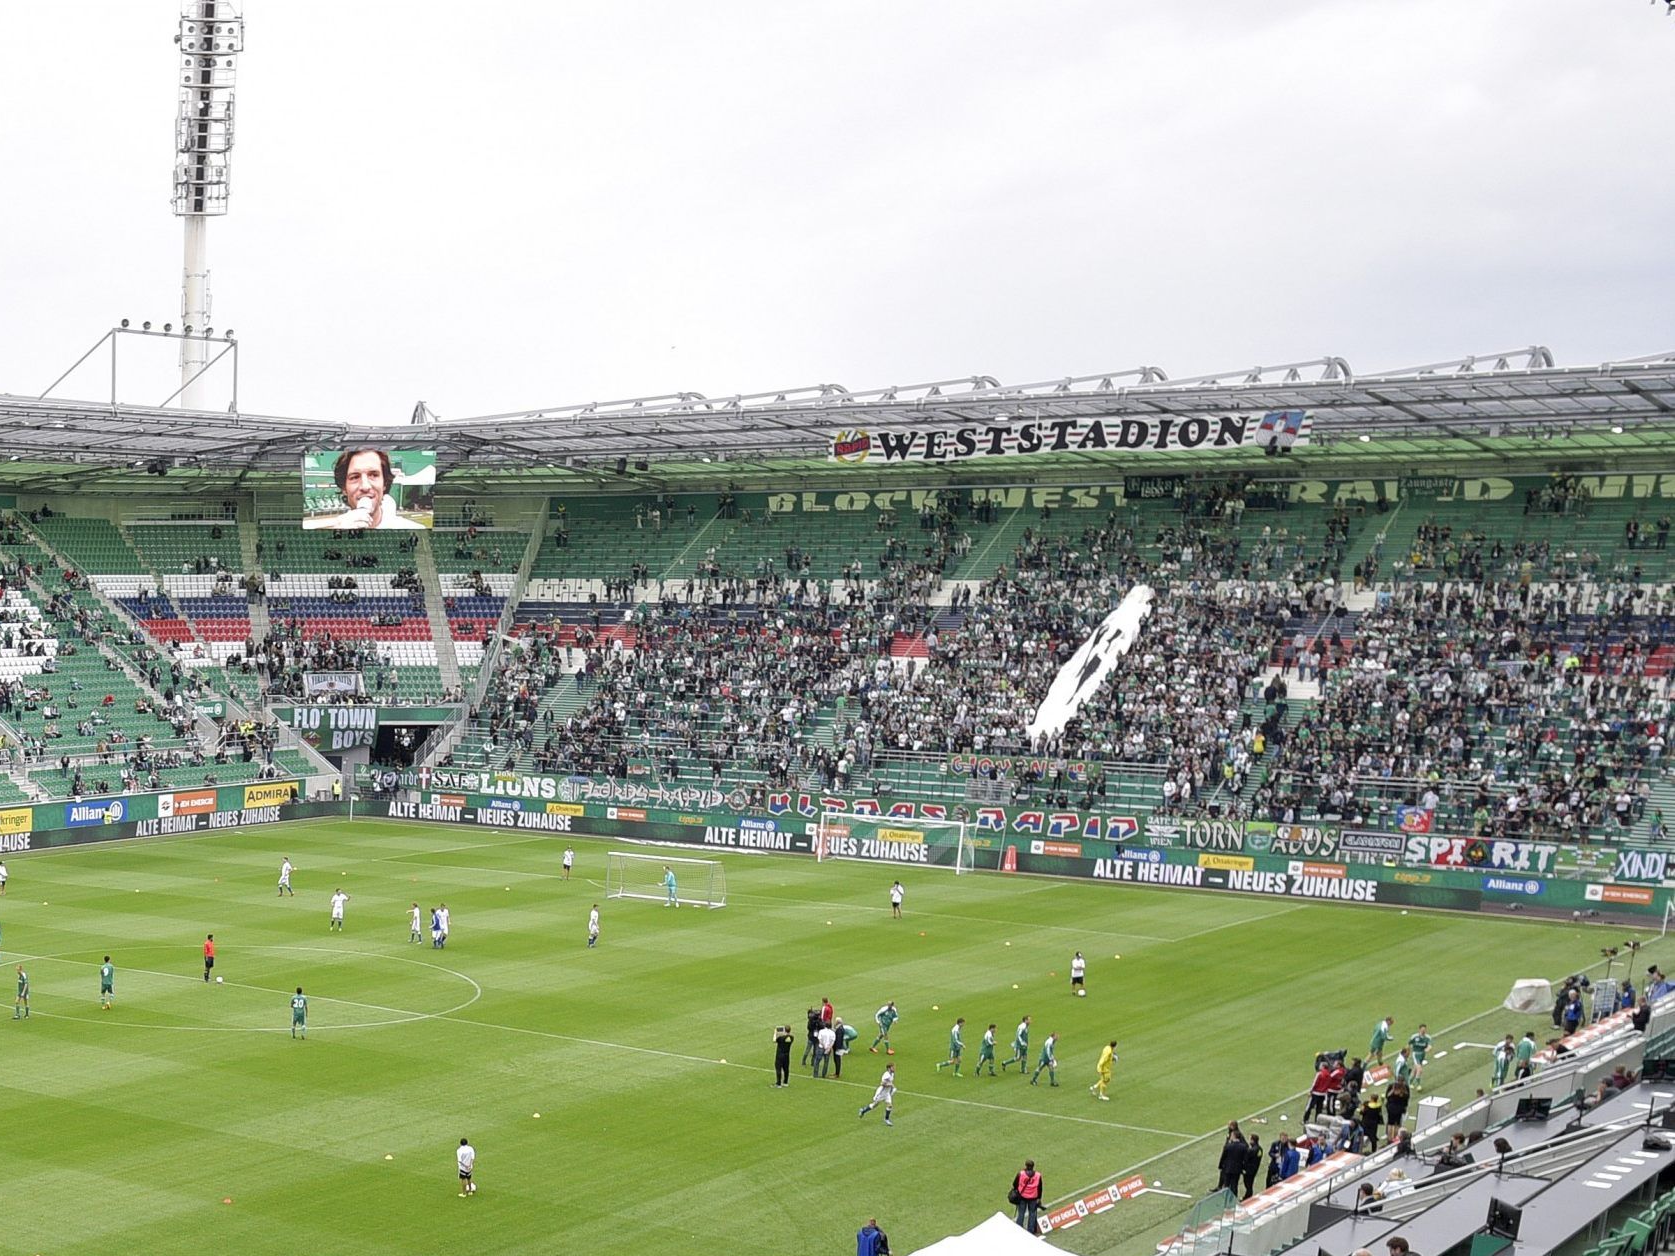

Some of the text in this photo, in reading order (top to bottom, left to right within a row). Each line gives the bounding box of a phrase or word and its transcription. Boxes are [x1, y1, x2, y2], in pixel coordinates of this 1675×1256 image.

[879, 416, 1249, 461] WESTSTADION
[768, 488, 939, 512] BLOCK
[327, 708, 377, 729] TOWN
[331, 730, 375, 750] BOYS
[246, 788, 291, 803] ADMIRA
[479, 772, 557, 800] LIONS
[70, 804, 106, 822] Allian
[136, 819, 159, 837] ALTE
[160, 813, 198, 834] HEIMAT
[209, 809, 238, 828] NEUES
[240, 805, 281, 825] ZUHAUSE
[388, 801, 416, 819] ALTE
[418, 803, 462, 822] HEIMAT
[477, 807, 515, 829] NEUES
[516, 810, 572, 832] ZUHAUSE
[740, 819, 765, 829] Allianz
[768, 792, 1140, 842] ULTRAS RAPID
[704, 826, 736, 845] ALTE
[739, 829, 793, 850] HEIMAT
[860, 837, 929, 863] ZUHAUSE
[1182, 818, 1245, 851] TORN
[1121, 850, 1148, 861] Allianz
[1491, 840, 1557, 873] RIT
[1093, 858, 1134, 880] ALTE
[1137, 861, 1206, 887] HEIMAT
[1228, 869, 1287, 895] NEUES
[1290, 874, 1378, 901] ZUHAUSE
[1487, 878, 1524, 891] Allianz
